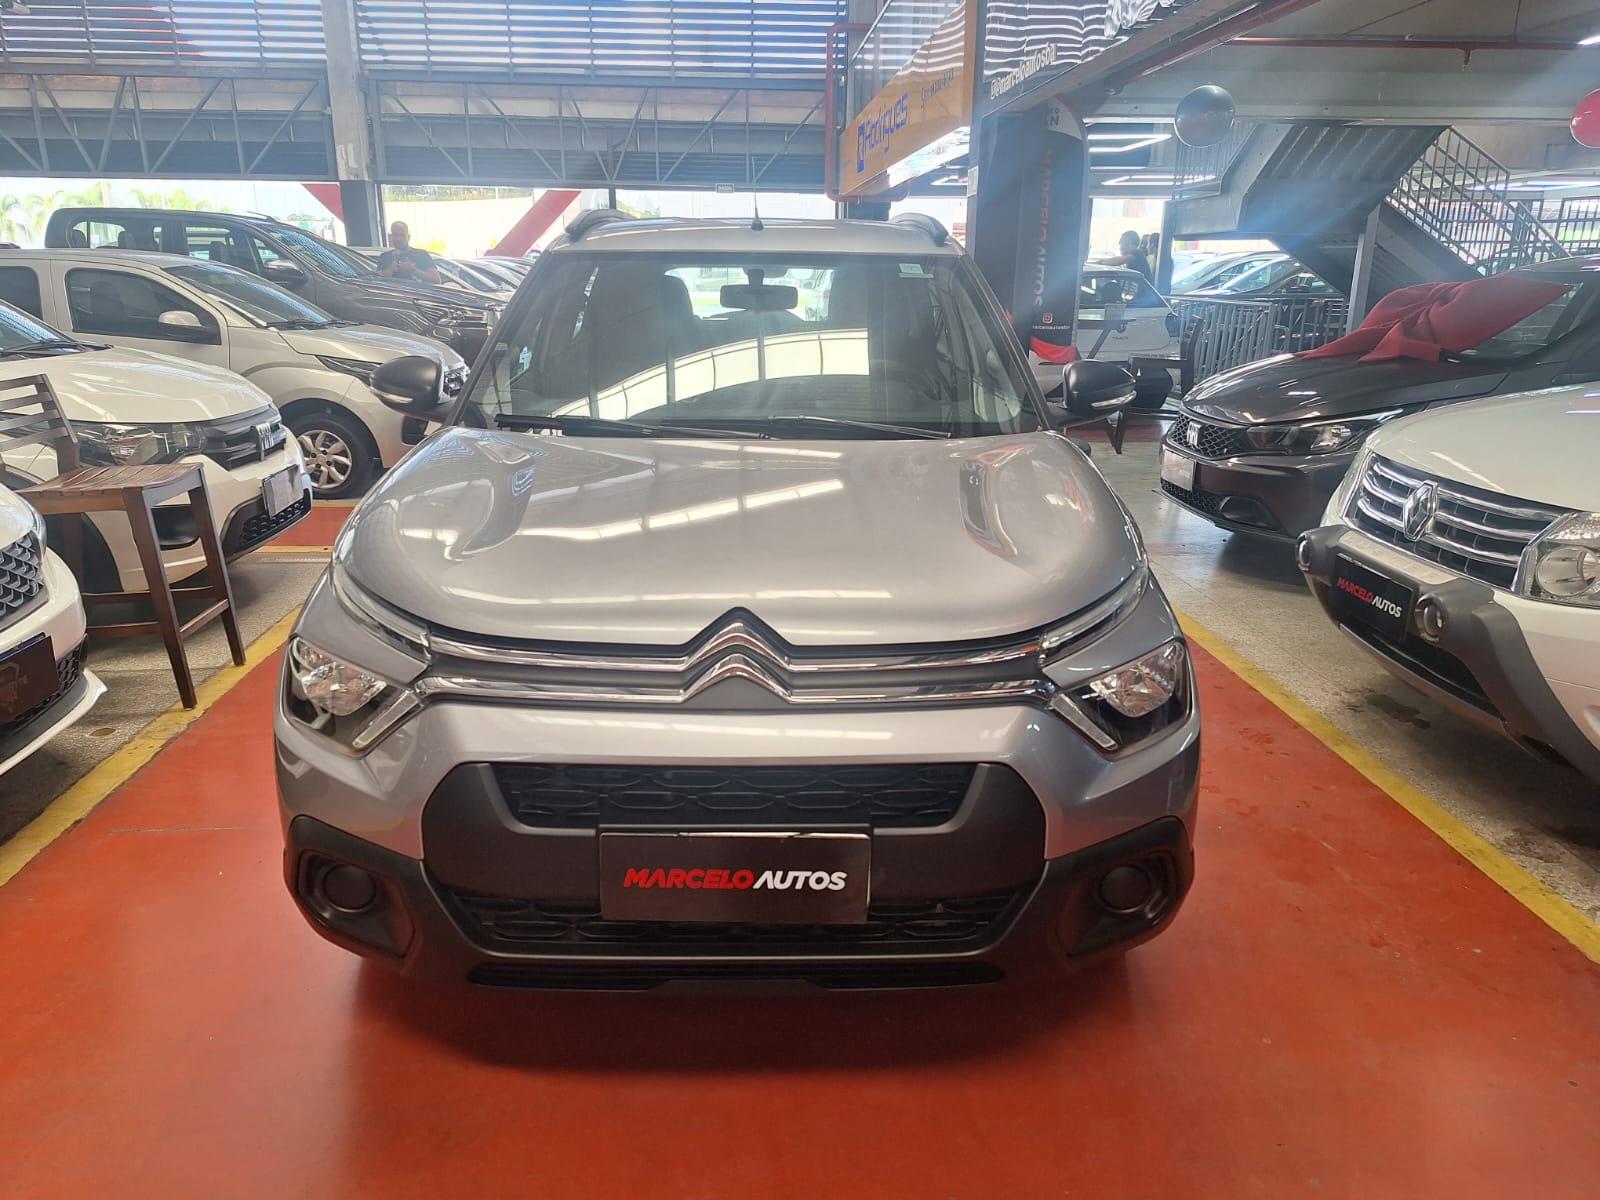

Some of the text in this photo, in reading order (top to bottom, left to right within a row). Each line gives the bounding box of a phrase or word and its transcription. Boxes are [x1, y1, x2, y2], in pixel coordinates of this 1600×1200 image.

[1337, 577, 1402, 618] MARCELO AUTOS
[624, 868, 847, 891] MARCELO AUTOS
